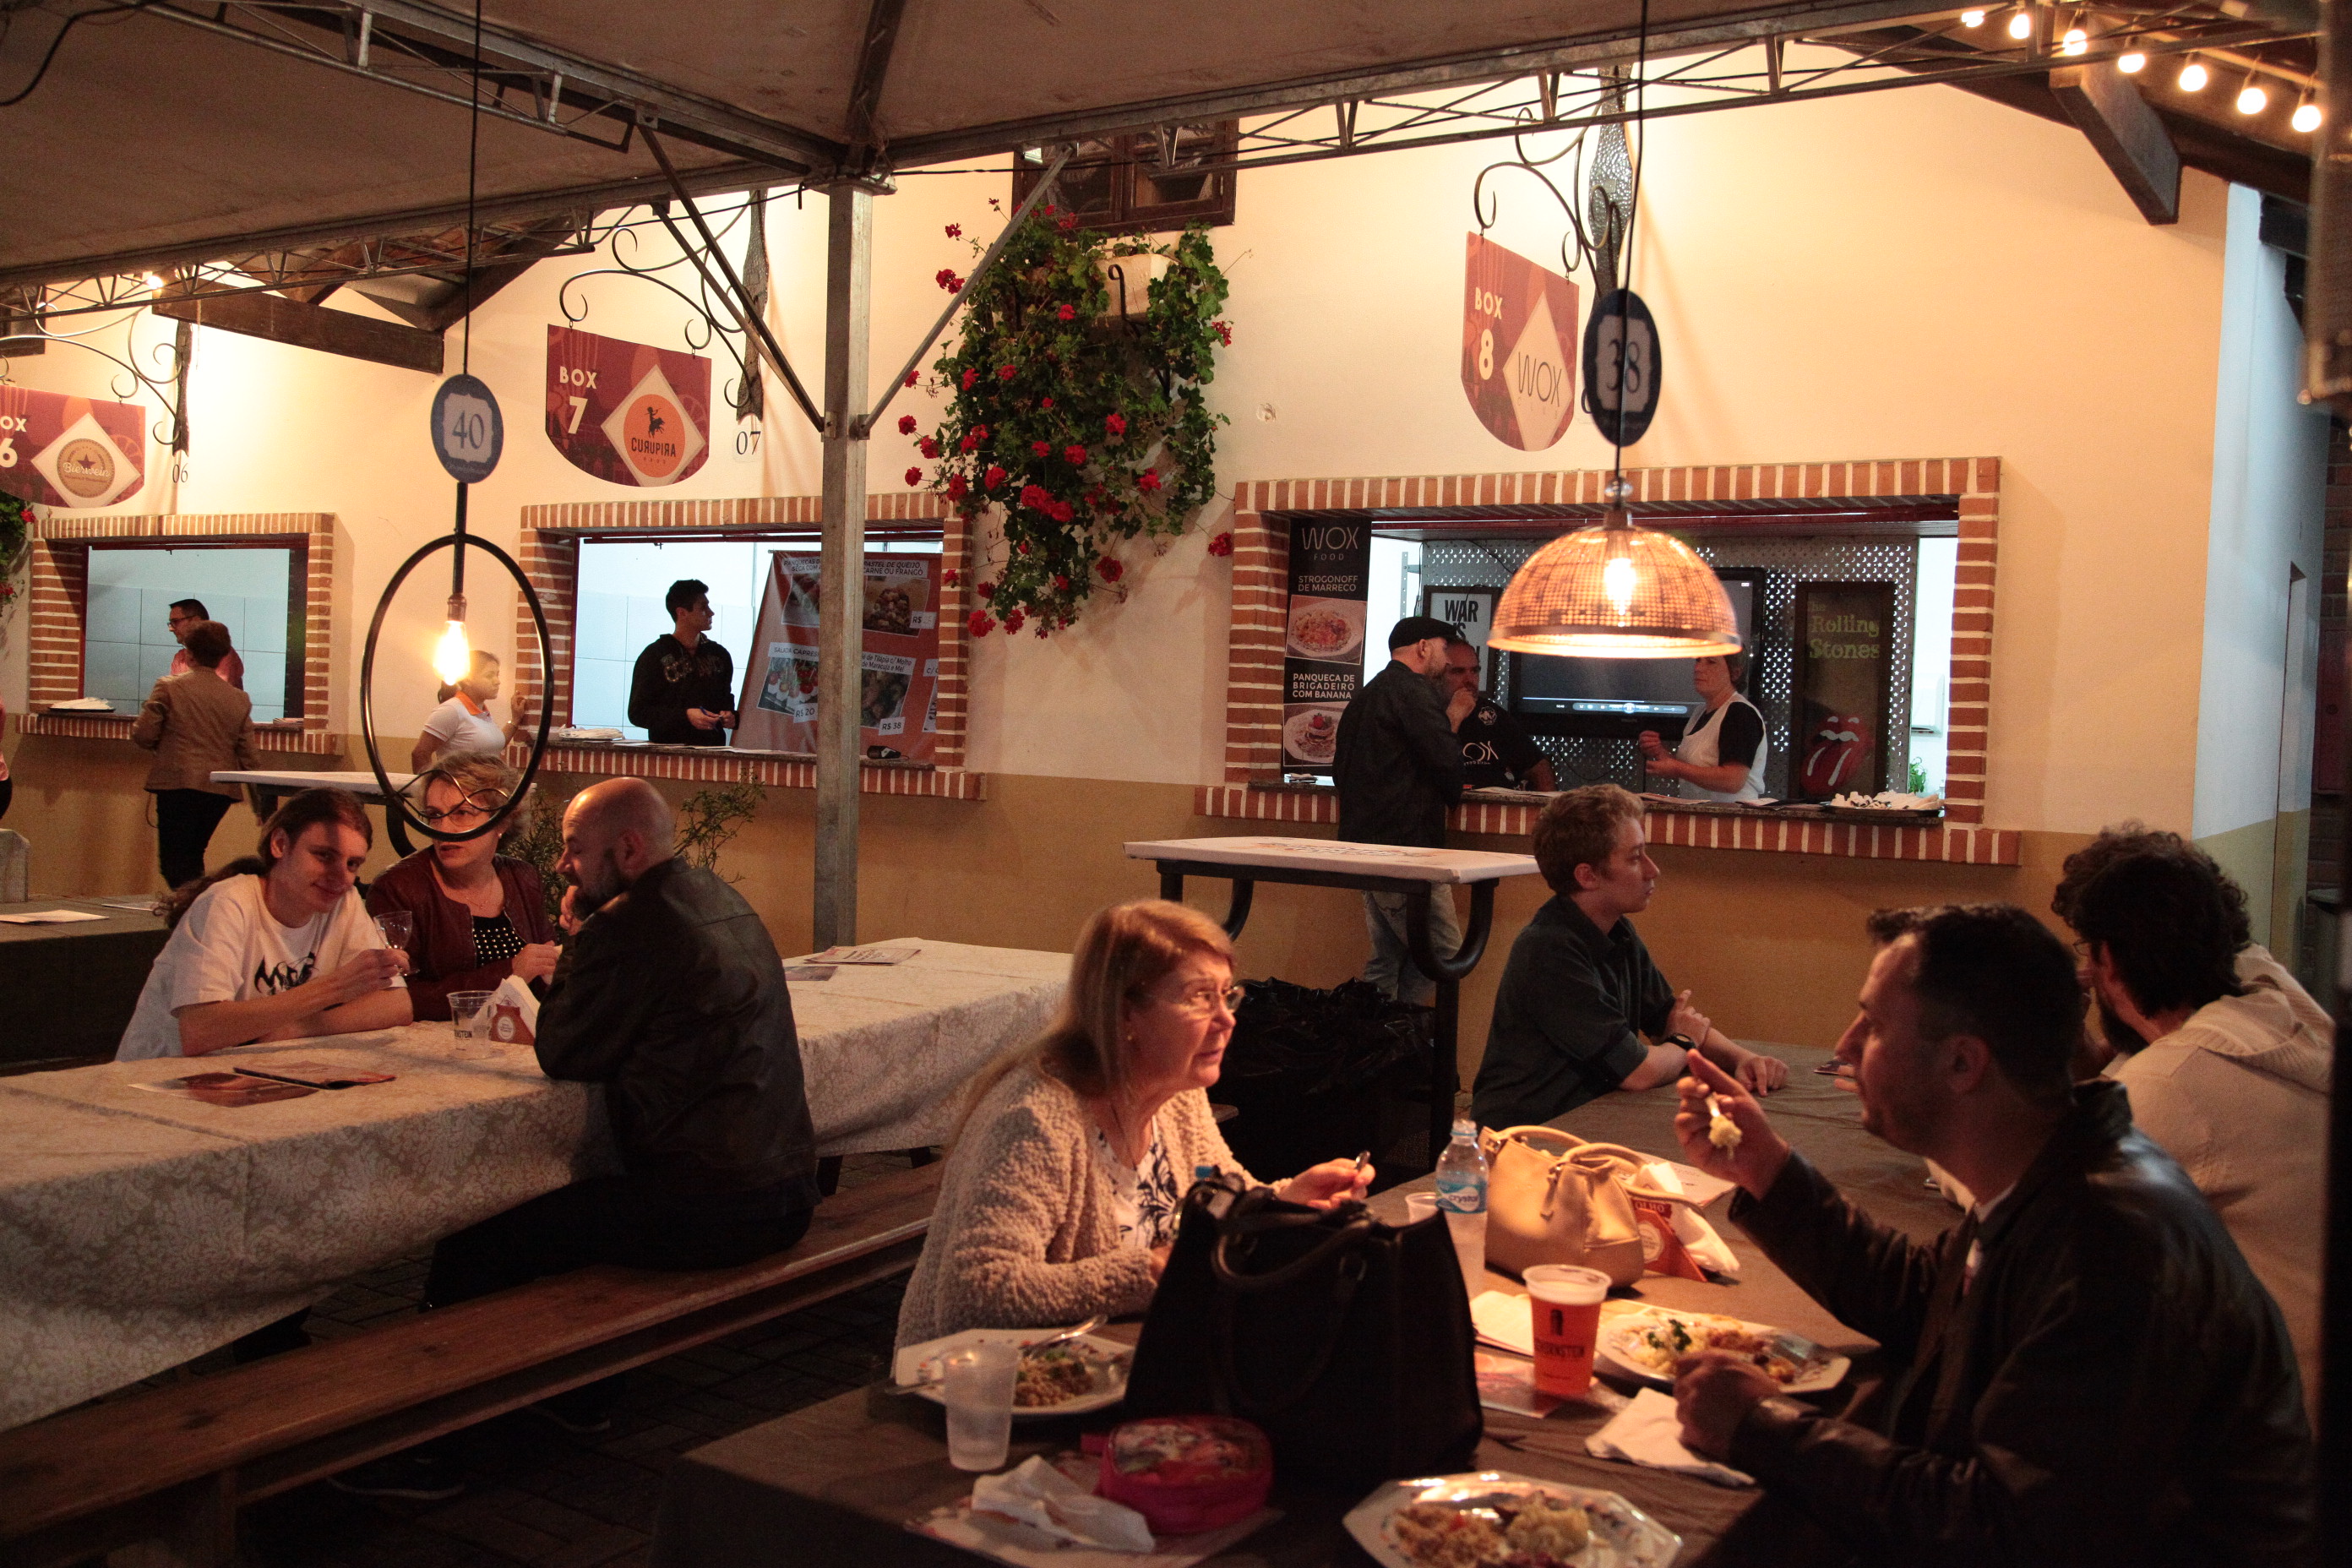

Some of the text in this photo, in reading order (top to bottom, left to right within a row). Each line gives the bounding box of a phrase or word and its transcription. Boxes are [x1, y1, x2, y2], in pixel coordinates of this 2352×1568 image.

[1475, 287, 1503, 319] BOX
[1478, 329, 1494, 380] 8
[559, 366, 597, 389] BOX
[1607, 339, 1641, 394] 38
[1518, 351, 1562, 407] WOX
[568, 395, 588, 434] 7
[452, 410, 485, 449] 40
[0, 438, 18, 468] 6
[631, 437, 677, 457] CURUPIRA
[736, 431, 761, 455] 07
[63, 461, 111, 477] Bierwein
[172, 463, 188, 483] 06
[1302, 526, 1359, 550] WOX
[1445, 599, 1478, 622] WAR
[1810, 614, 1880, 638] Rolling
[793, 648, 819, 657] CAPRES
[1810, 639, 1880, 659] Stones
[1293, 672, 1355, 683] PANQUECA DE
[1293, 682, 1355, 690] BRIGADEIRO
[1293, 689, 1353, 699] COM BANANA
